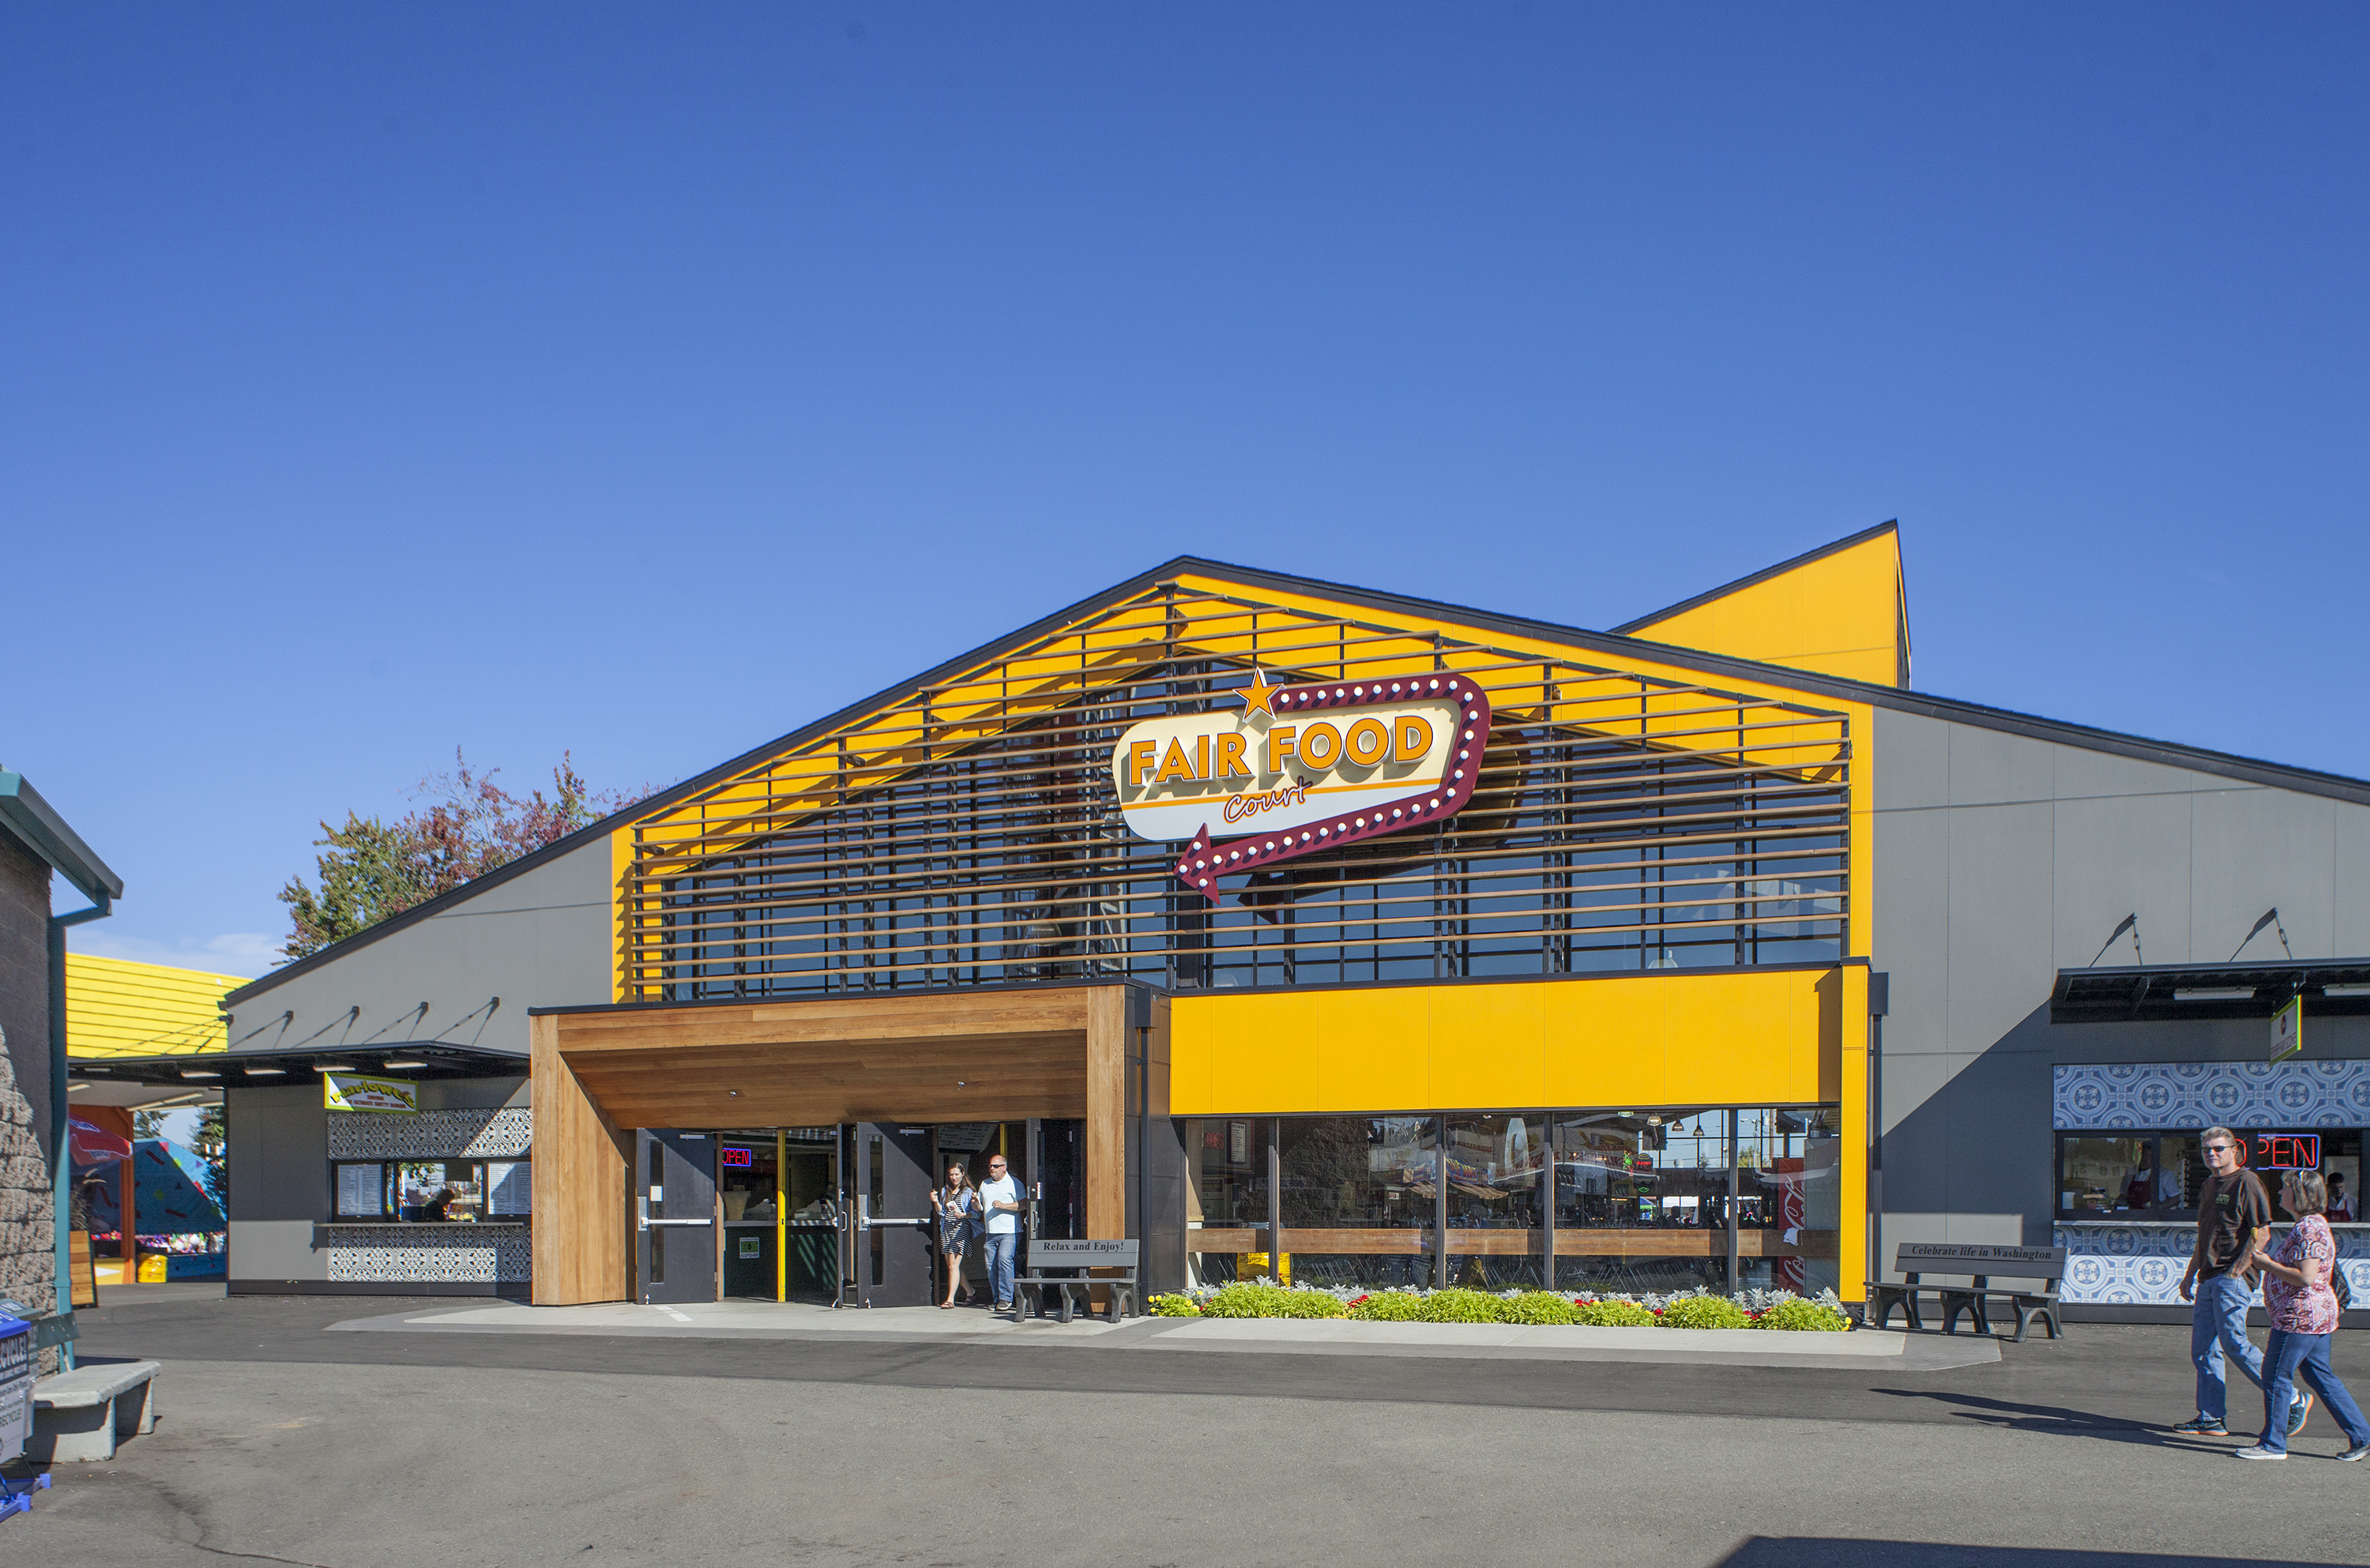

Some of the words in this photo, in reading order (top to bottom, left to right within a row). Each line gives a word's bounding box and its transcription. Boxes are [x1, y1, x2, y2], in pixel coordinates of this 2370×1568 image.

[1130, 731, 1255, 787] FAIR
[1268, 715, 1435, 775] FOOD
[1224, 776, 1313, 824] Court
[722, 1149, 750, 1165] OPEN
[1043, 1242, 1070, 1251] Relax
[1073, 1242, 1091, 1251] and
[1093, 1242, 1124, 1253] Enjoy!
[1911, 1245, 1958, 1256] Celebrate
[1959, 1246, 1976, 1257] life
[1978, 1247, 1988, 1257] in
[1992, 1247, 2052, 1262] Washington
[0, 1334, 28, 1369] CYCLE!
